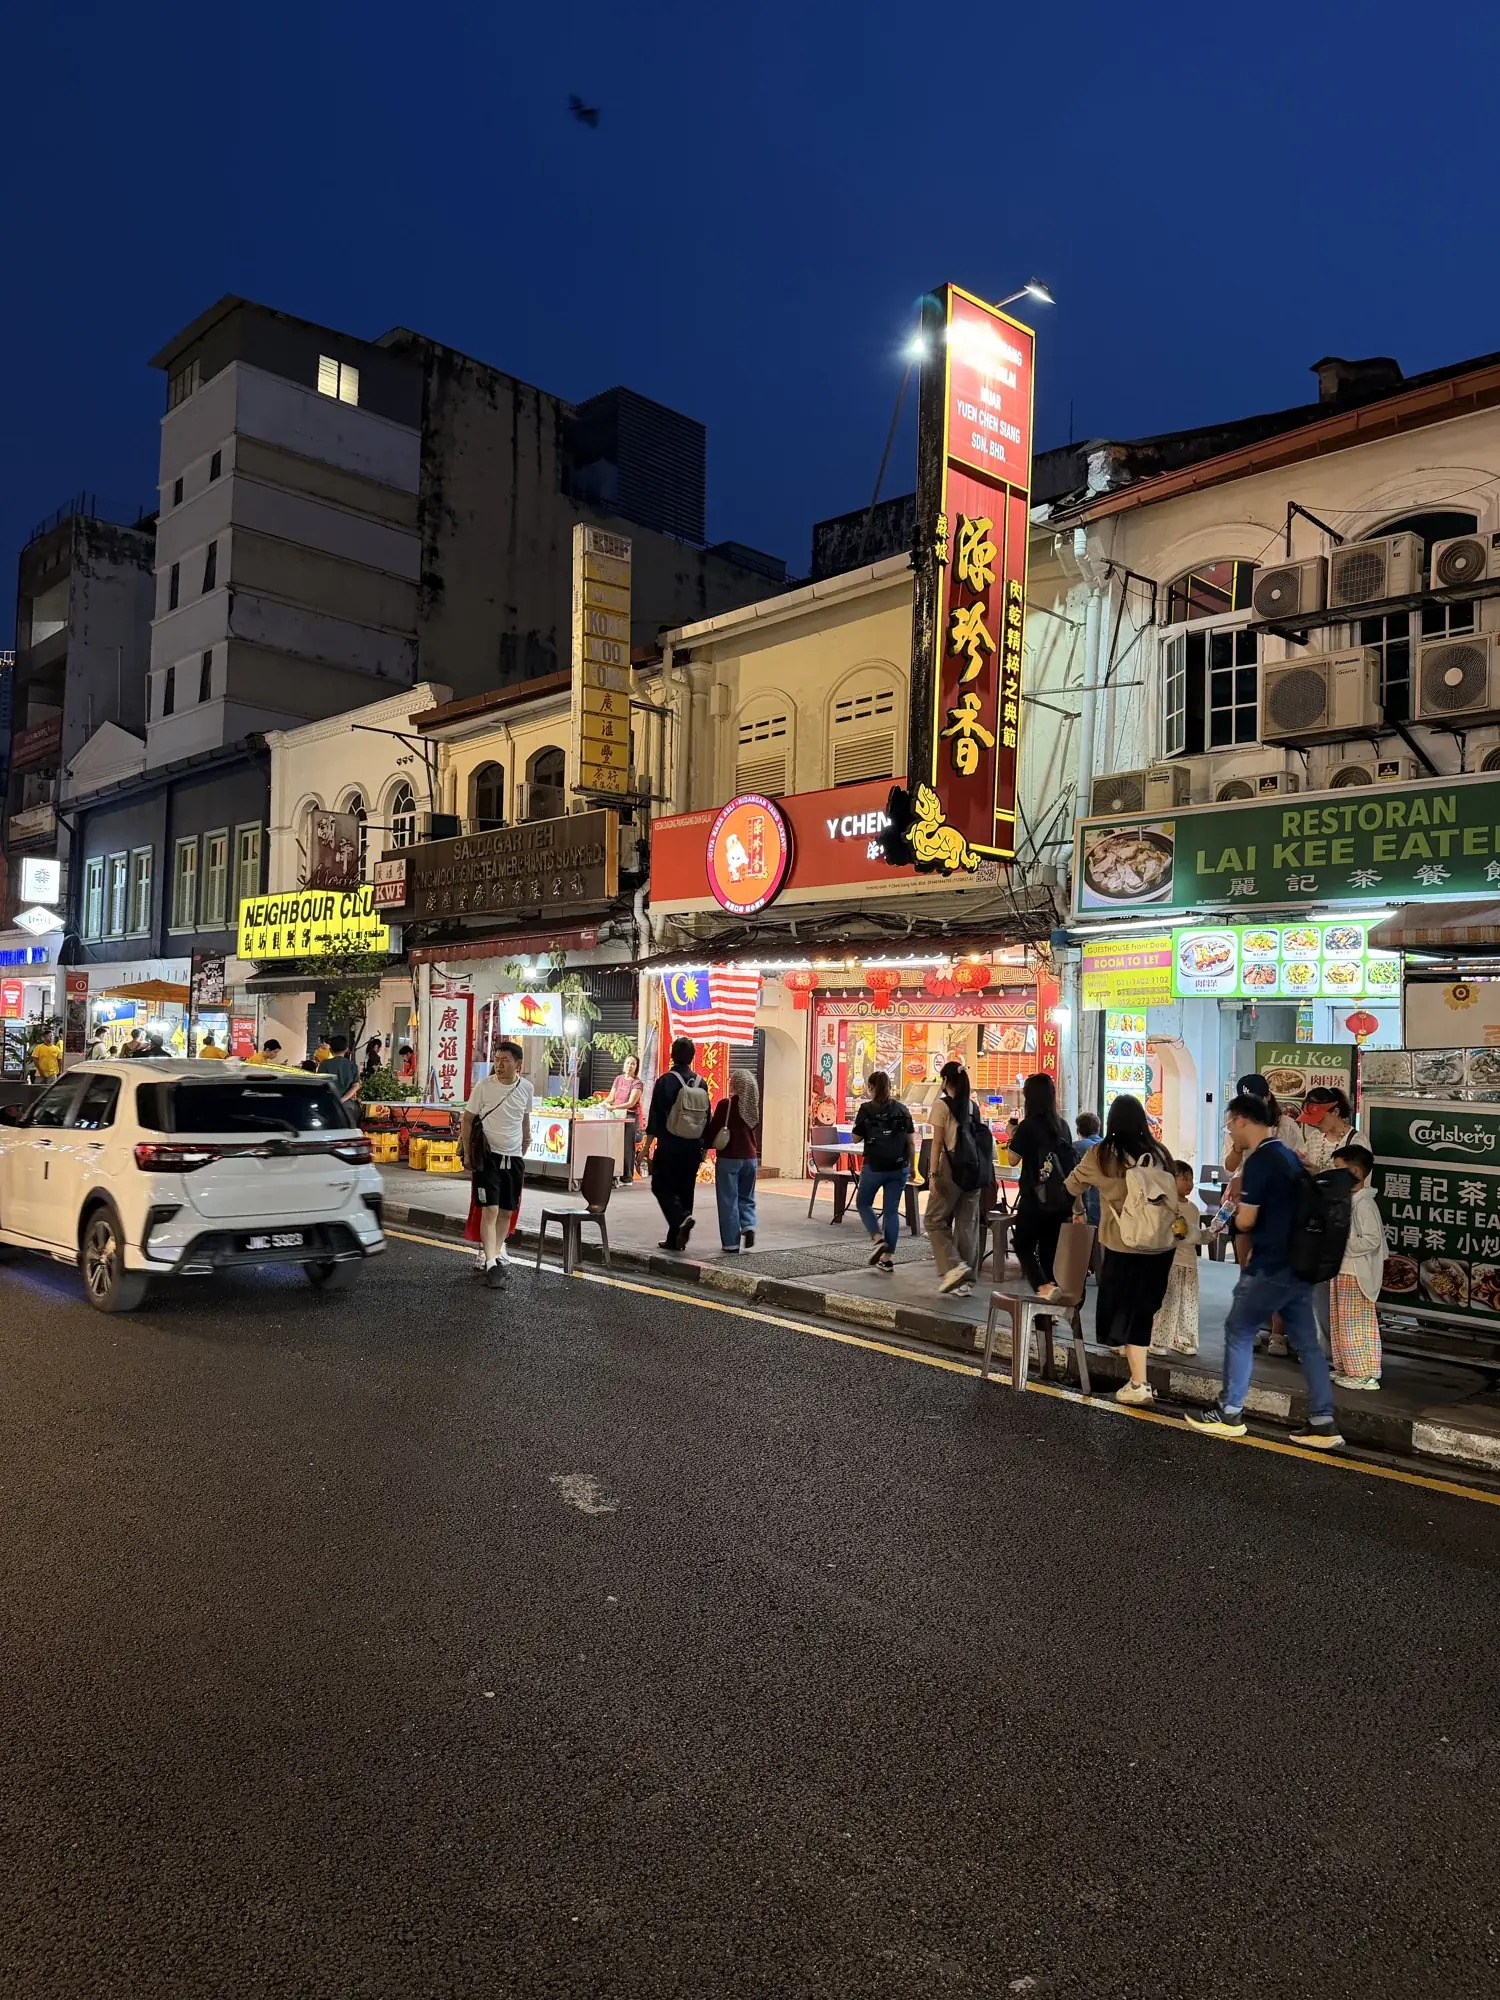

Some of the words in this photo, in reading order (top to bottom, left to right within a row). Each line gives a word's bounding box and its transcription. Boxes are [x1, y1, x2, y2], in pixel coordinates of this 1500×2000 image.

[957, 399, 977, 422] YUEN
[979, 411, 999, 433] CHEN
[1000, 420, 1021, 444] SIANG
[972, 432, 988, 453] SDN.
[990, 440, 1006, 463] BHD.
[826, 818, 840, 839] Y
[841, 811, 892, 837] CHEN
[1282, 794, 1457, 838] RESTORAN
[1196, 845, 1257, 875] LAI
[1272, 837, 1356, 869] KEE
[375, 882, 404, 902] KWF
[244, 895, 335, 928] NEIGHBOUR
[340, 890, 380, 919] CLU
[1087, 944, 1129, 954] GUESTHOUSE
[1094, 957, 1124, 969] ROOM
[1127, 956, 1141, 967] TO
[1143, 954, 1159, 965] LET
[1268, 1050, 1301, 1065] Lai
[1304, 1051, 1343, 1067] Kee
[1409, 1119, 1497, 1151] Carlsberg
[1383, 1172, 1500, 1210] 麗記茶
[1391, 1202, 1422, 1221] LAI
[1428, 1207, 1468, 1226] KEE
[1383, 1223, 1447, 1251] 肉骨茶
